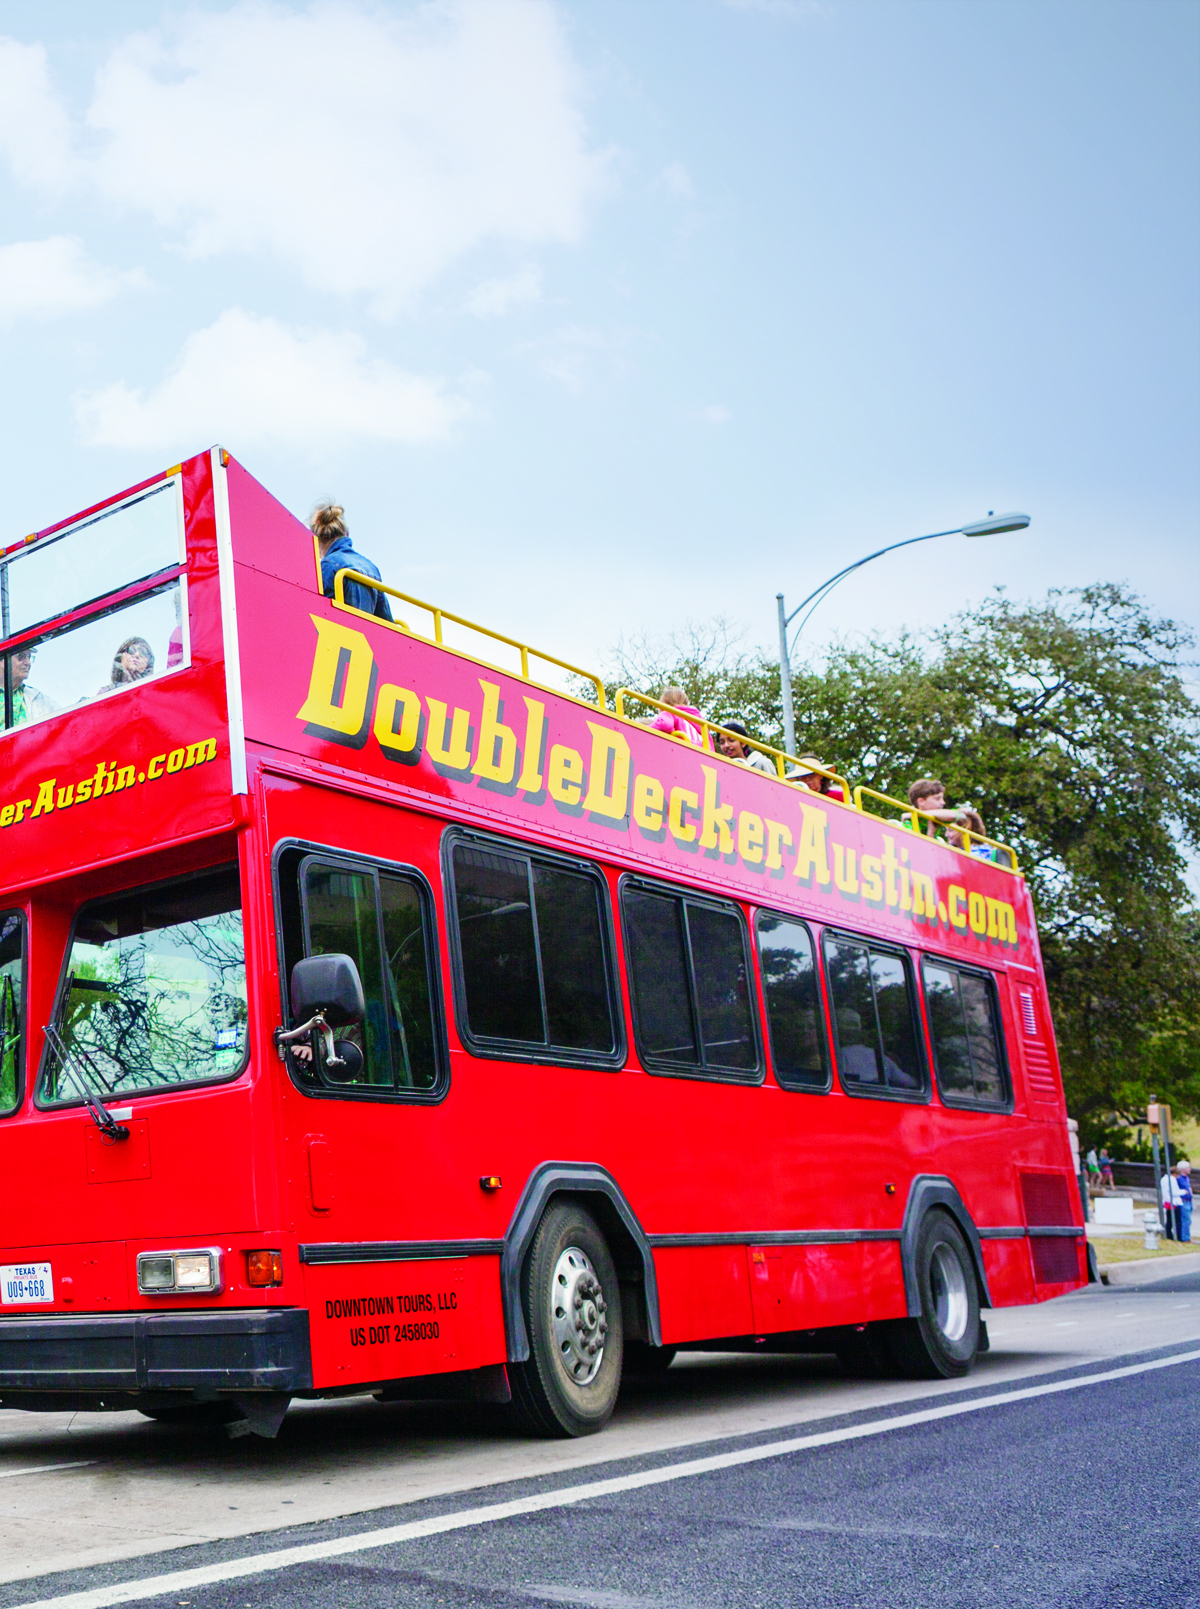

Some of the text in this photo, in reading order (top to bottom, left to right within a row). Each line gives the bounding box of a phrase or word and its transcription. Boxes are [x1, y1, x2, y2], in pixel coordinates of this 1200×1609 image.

[296, 613, 1018, 945] DoubleDeckerAustin.com
[15, 1267, 36, 1275] TEXAS
[325, 1292, 458, 1319] DOWNTOWN TOURS, LLC
[350, 1321, 439, 1347] US DOT 2458030
